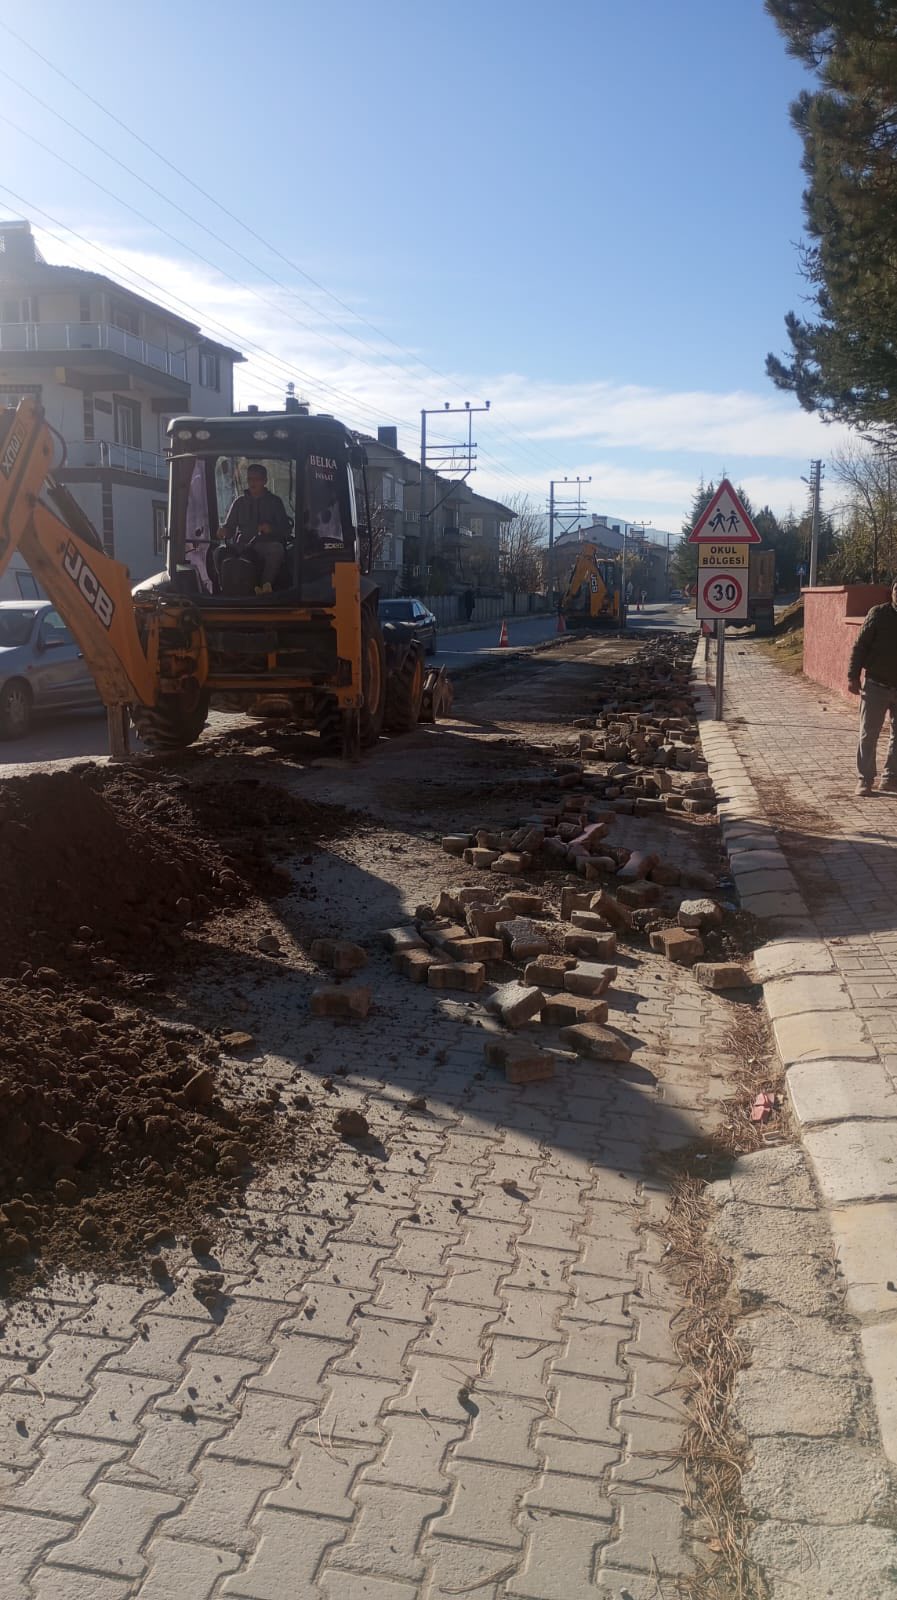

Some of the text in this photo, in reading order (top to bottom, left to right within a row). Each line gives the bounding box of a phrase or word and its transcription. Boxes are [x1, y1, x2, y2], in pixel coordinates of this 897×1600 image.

[310, 455, 338, 470] BELKA
[710, 546, 737, 554] OKUL
[702, 556, 745, 565] BÖLGESİ
[63, 540, 113, 627] JCB
[713, 584, 736, 601] 30
